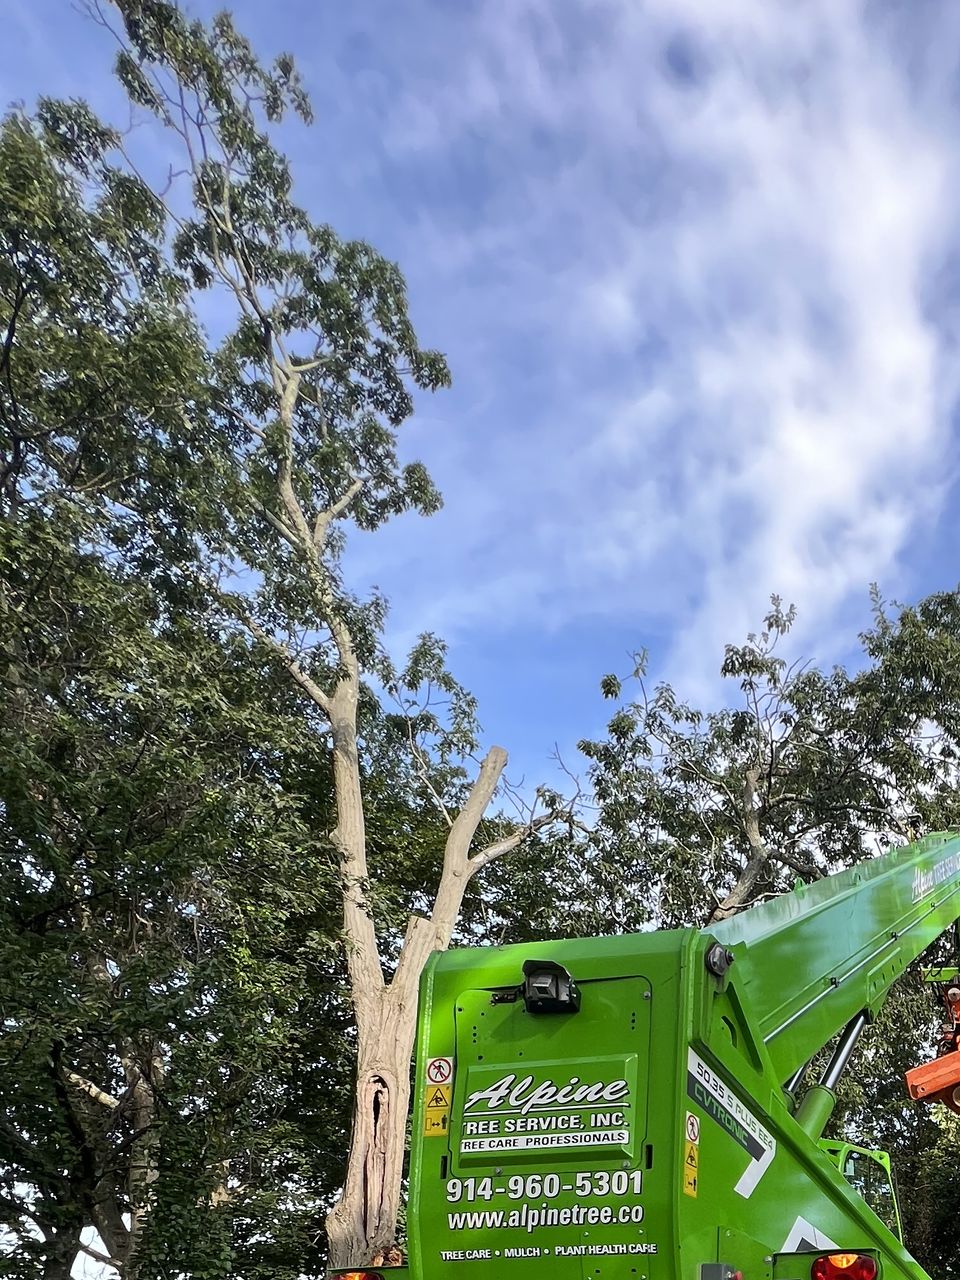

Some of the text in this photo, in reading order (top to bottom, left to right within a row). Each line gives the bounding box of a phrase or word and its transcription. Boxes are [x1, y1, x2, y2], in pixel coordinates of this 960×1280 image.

[464, 1074, 629, 1115] Alpine
[696, 1062, 725, 1099] 50.35
[727, 1094, 734, 1109] S
[735, 1101, 757, 1134] PLUS
[463, 1112, 629, 1135] REE SERVICE, INC.
[694, 1082, 748, 1147] CVTRONIC
[462, 1132, 626, 1150] REE CARE PROFESSIONALS
[446, 1170, 642, 1202] 914-960-5301
[447, 1203, 644, 1233] www.alpinetree.co
[441, 1251, 464, 1261] TREE
[466, 1249, 491, 1260] CARE
[504, 1247, 540, 1258] MULCH
[554, 1245, 588, 1256] PLANT
[588, 1244, 627, 1255] HEALTH
